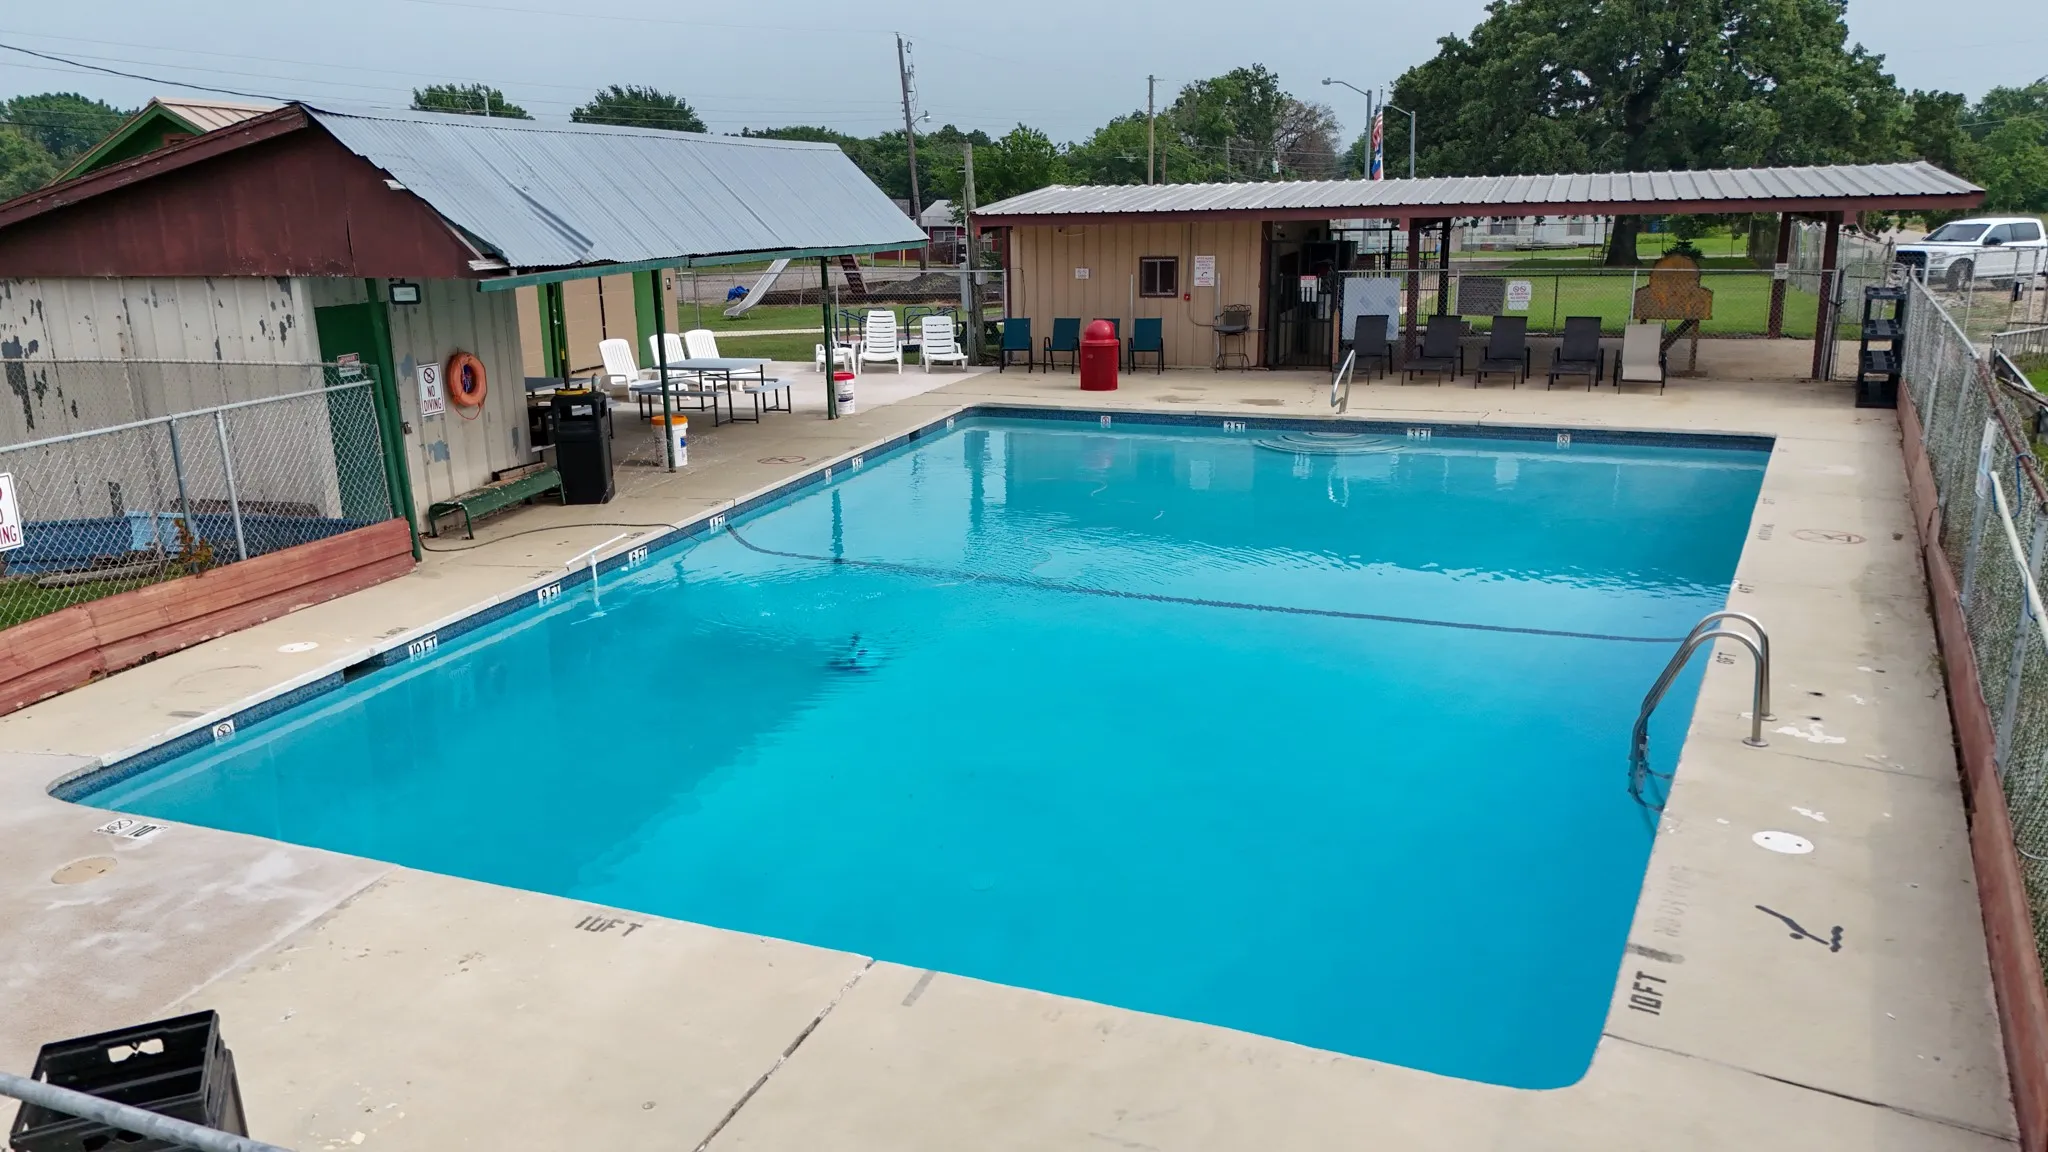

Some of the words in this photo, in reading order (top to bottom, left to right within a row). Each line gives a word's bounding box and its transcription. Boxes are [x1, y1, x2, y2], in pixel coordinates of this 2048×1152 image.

[426, 384, 436, 397] NO
[423, 397, 442, 412] DIVING
[1235, 421, 1245, 432] FT
[1419, 428, 1431, 440] FT
[550, 583, 560, 597] FT
[411, 643, 422, 657] 10
[423, 636, 436, 652] FT
[129, 825, 157, 837] 10
[1628, 971, 1667, 1015] 10FT
